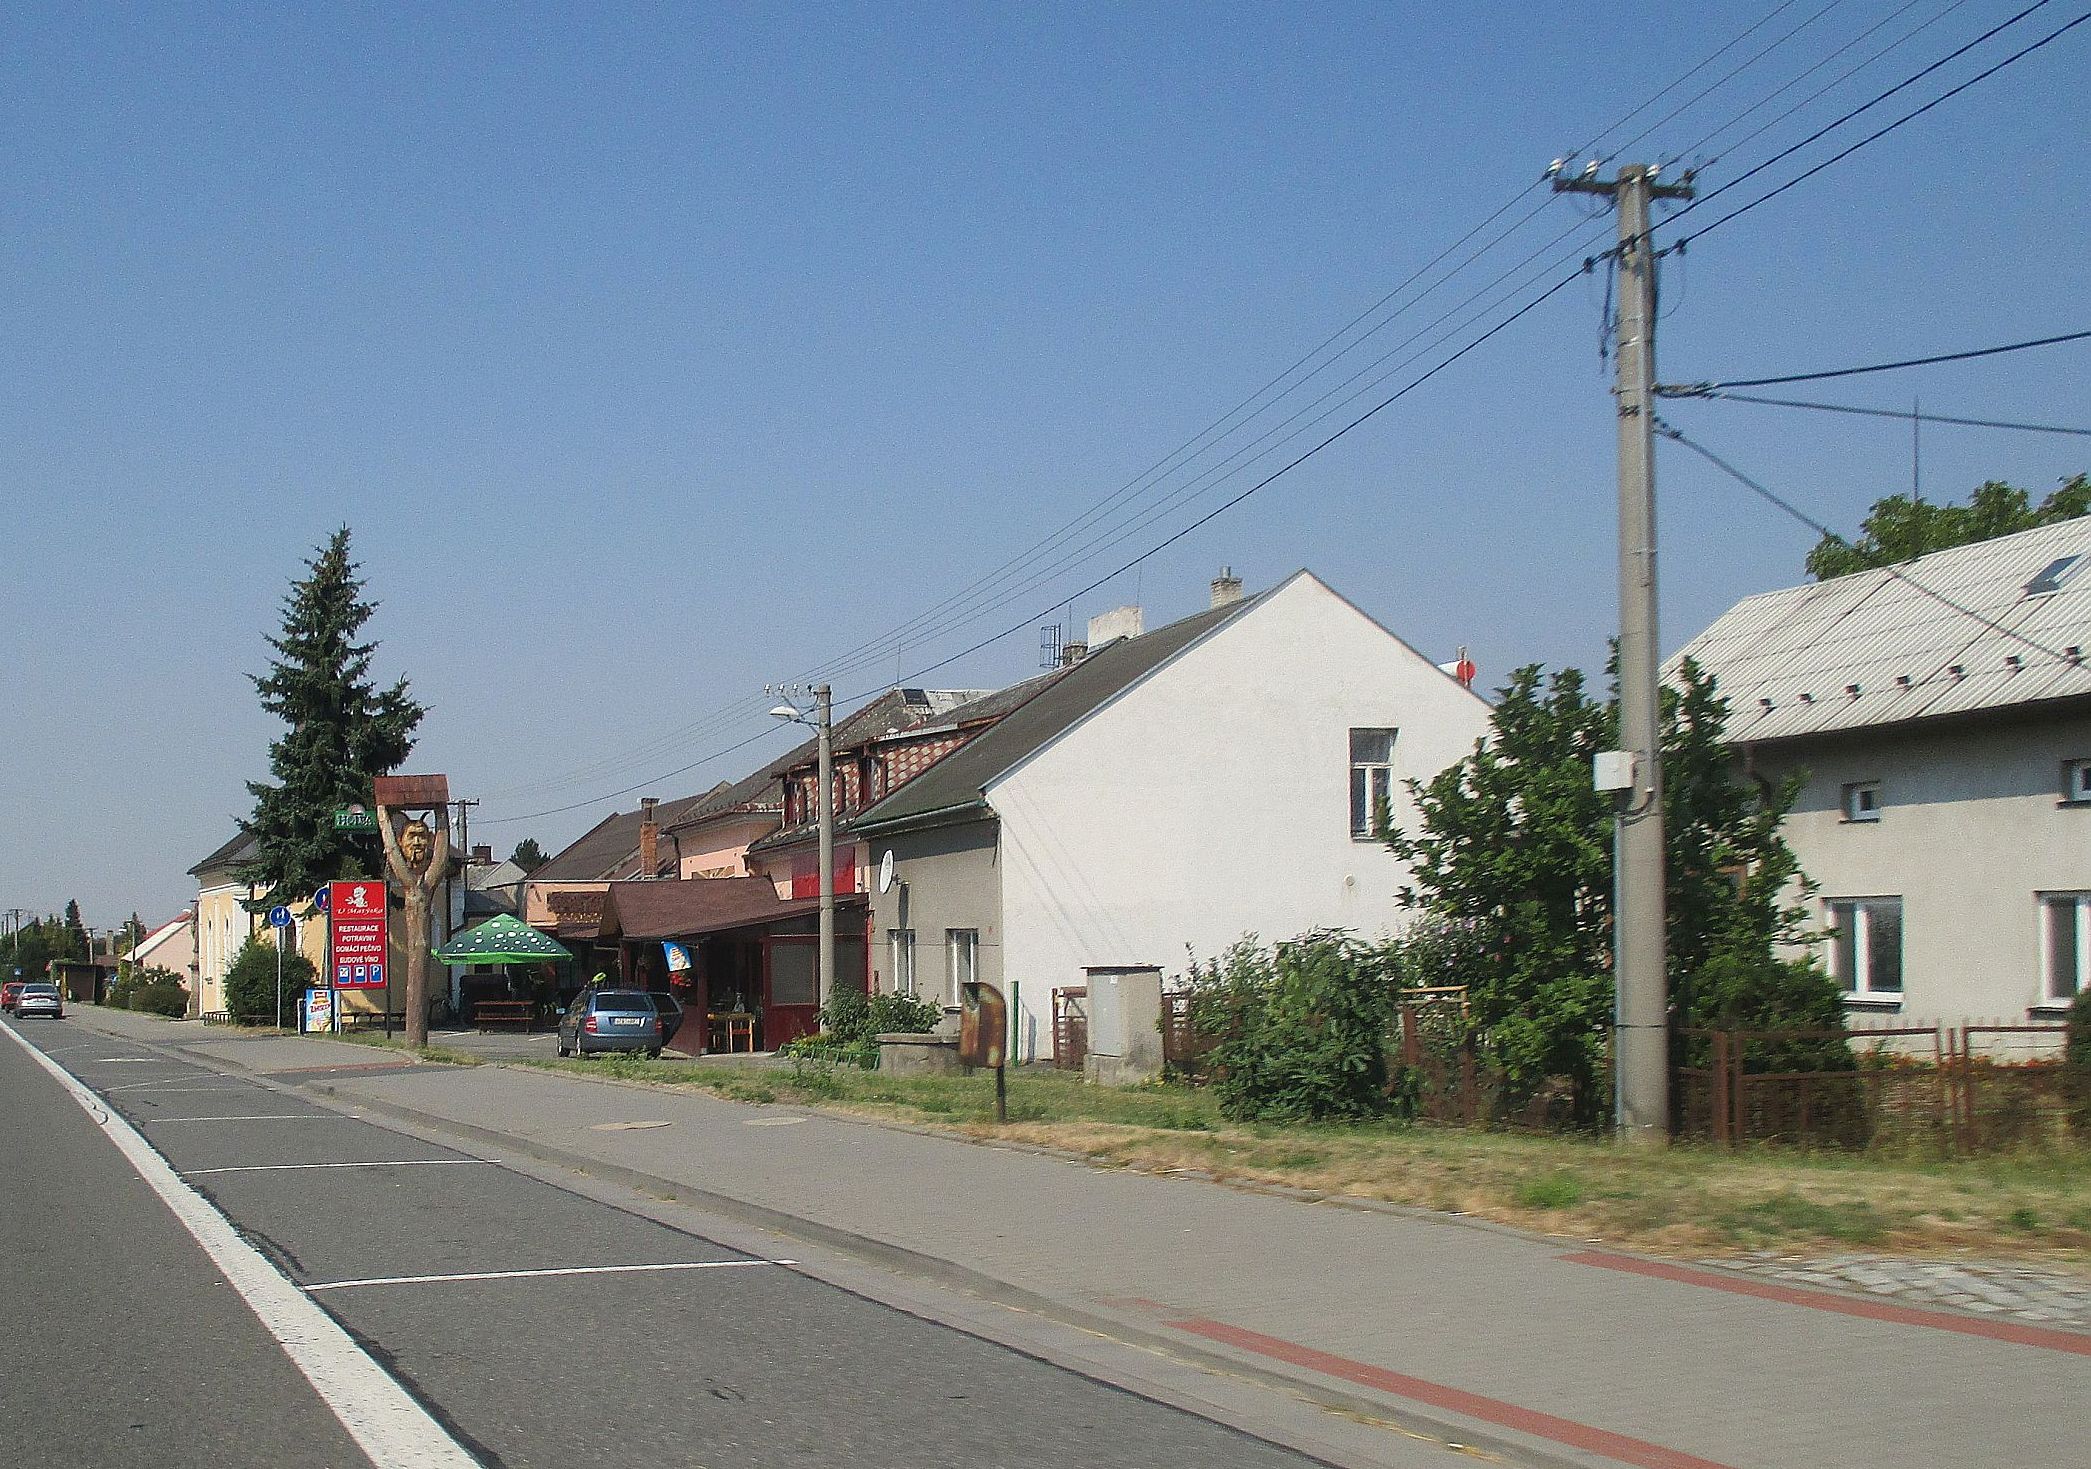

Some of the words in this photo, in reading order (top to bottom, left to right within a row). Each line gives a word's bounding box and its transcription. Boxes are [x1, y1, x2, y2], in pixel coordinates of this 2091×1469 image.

[338, 924, 379, 932] RESTAURACE
[341, 934, 377, 942] POTRAVINY
[335, 944, 360, 953] DOMÁCÍ
[360, 943, 382, 952] PEČIVO
[364, 954, 379, 963] VÍNO
